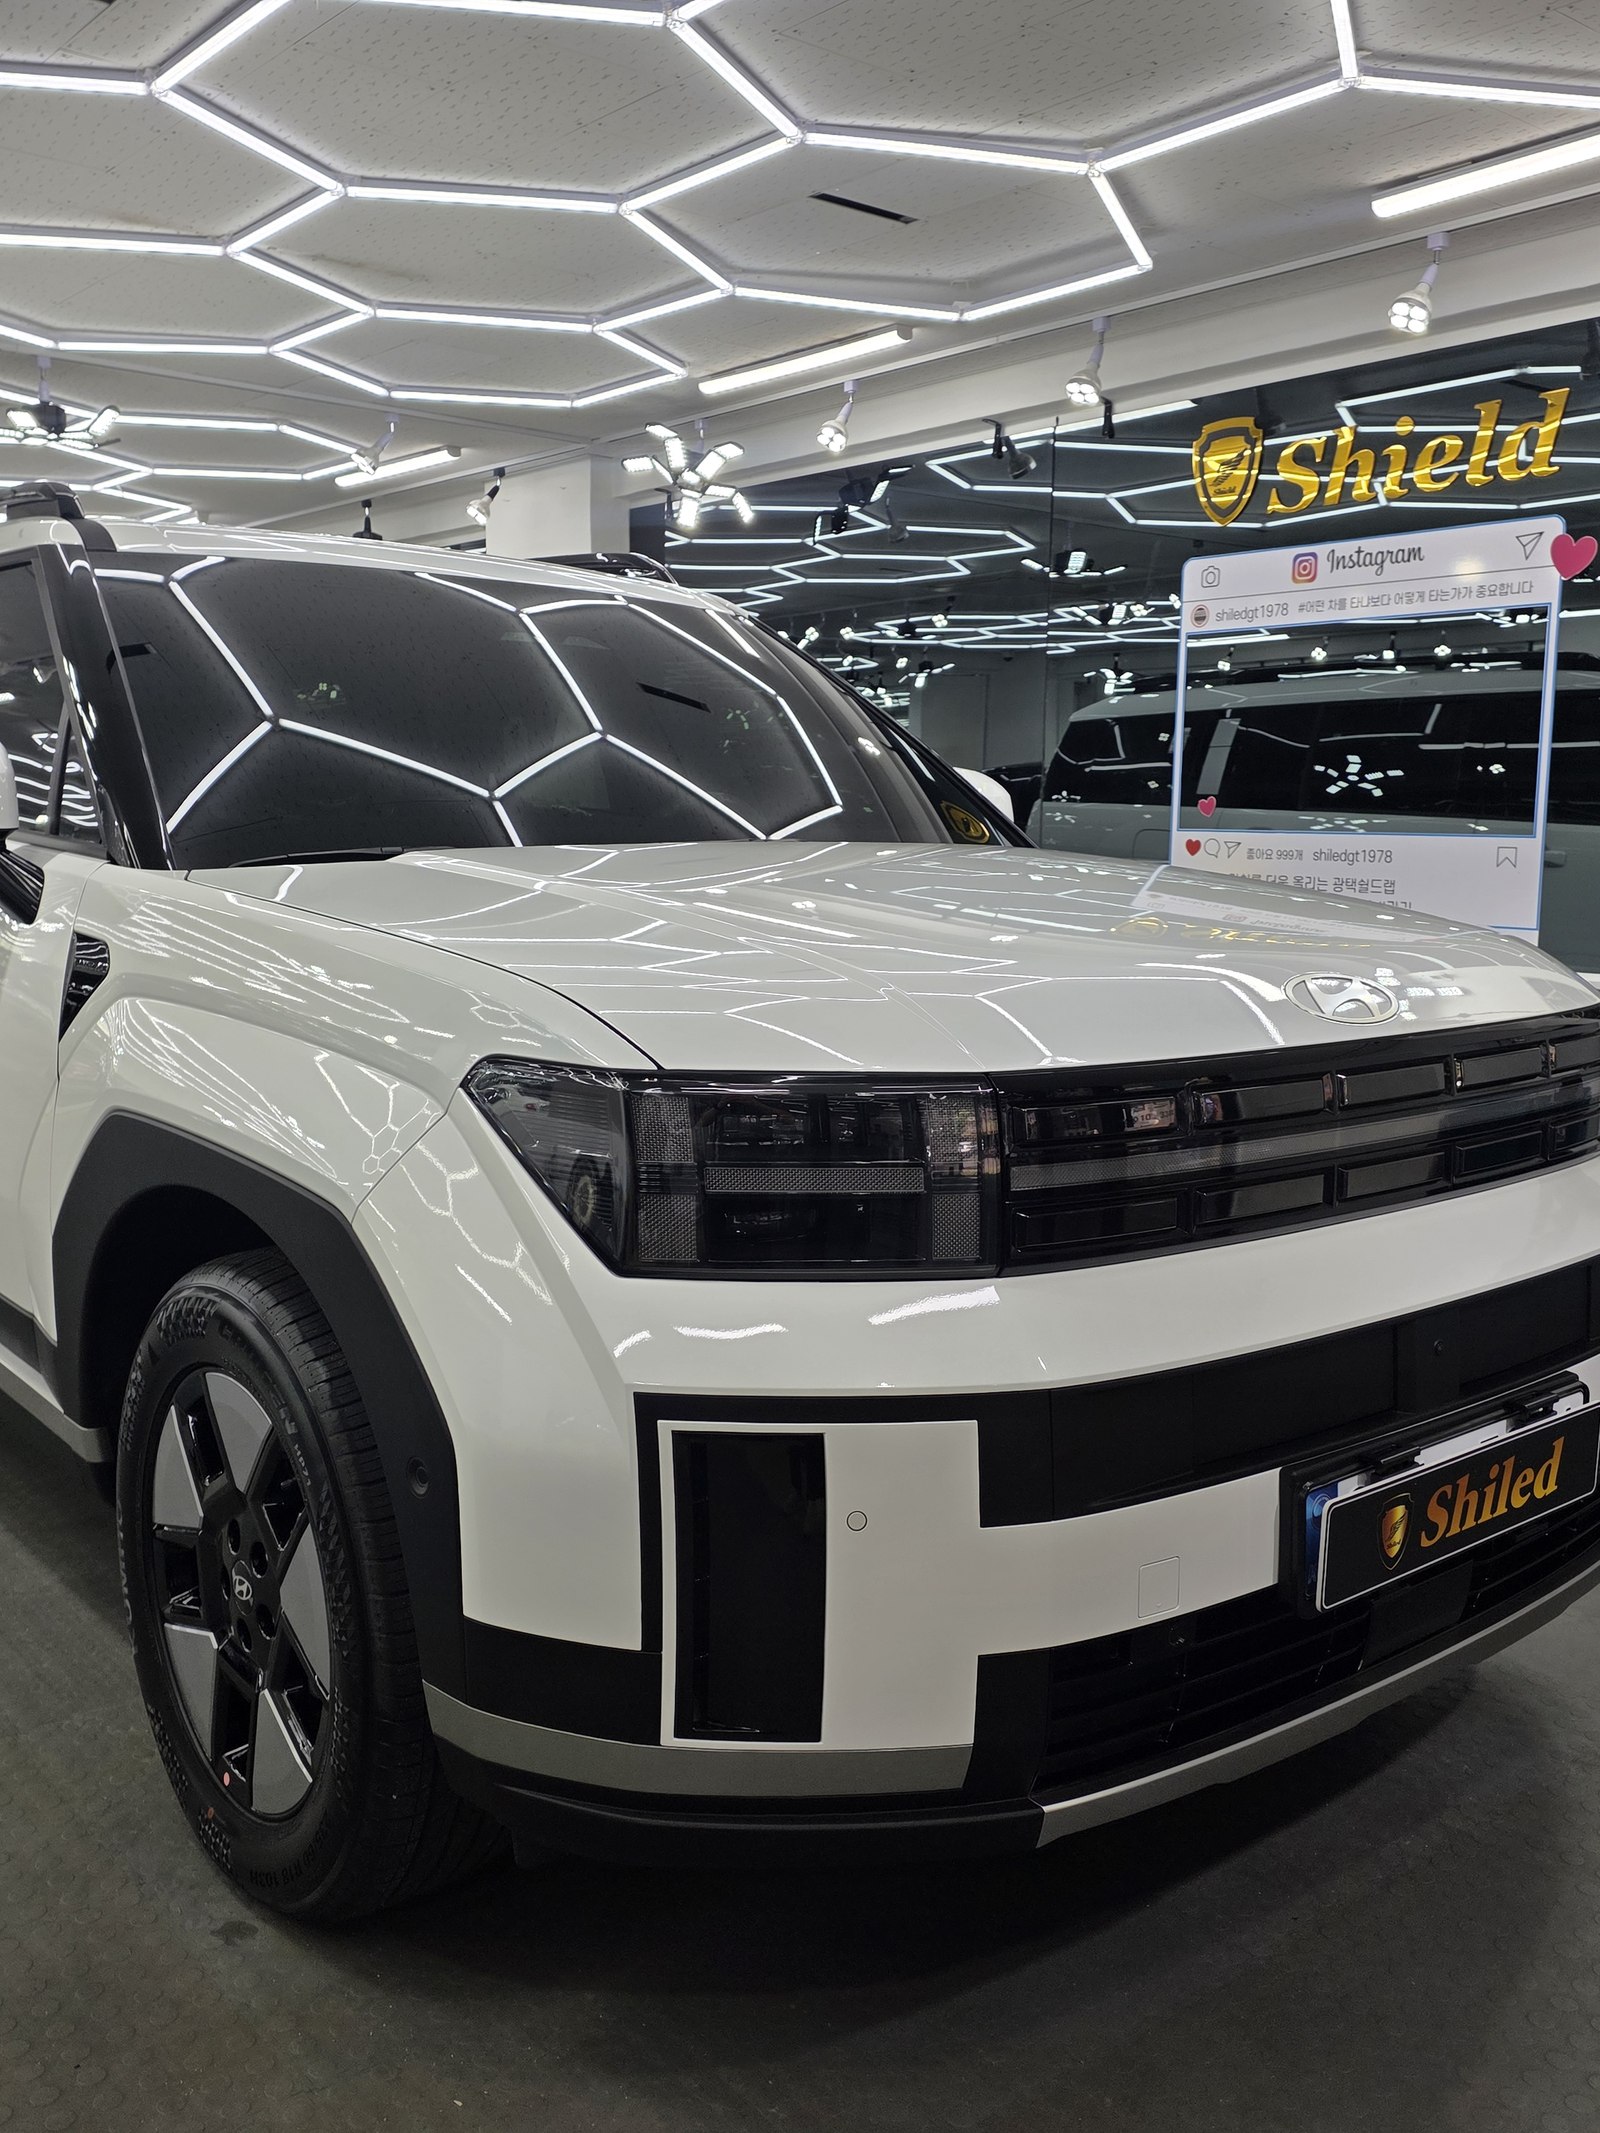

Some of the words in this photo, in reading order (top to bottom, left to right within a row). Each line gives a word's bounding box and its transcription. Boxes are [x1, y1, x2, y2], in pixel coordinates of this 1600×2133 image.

[1266, 387, 1571, 514] Shield
[1326, 546, 1425, 576] Instagram
[1215, 602, 1289, 622] shiledgt1978
[1393, 590, 1426, 606] 어떻게
[1476, 580, 1534, 599] 중요합니다
[1246, 848, 1274, 860] 좋아요
[1275, 849, 1304, 860] 999개
[1312, 848, 1393, 866] shiledgt1978
[1419, 1436, 1565, 1548] Shiled
